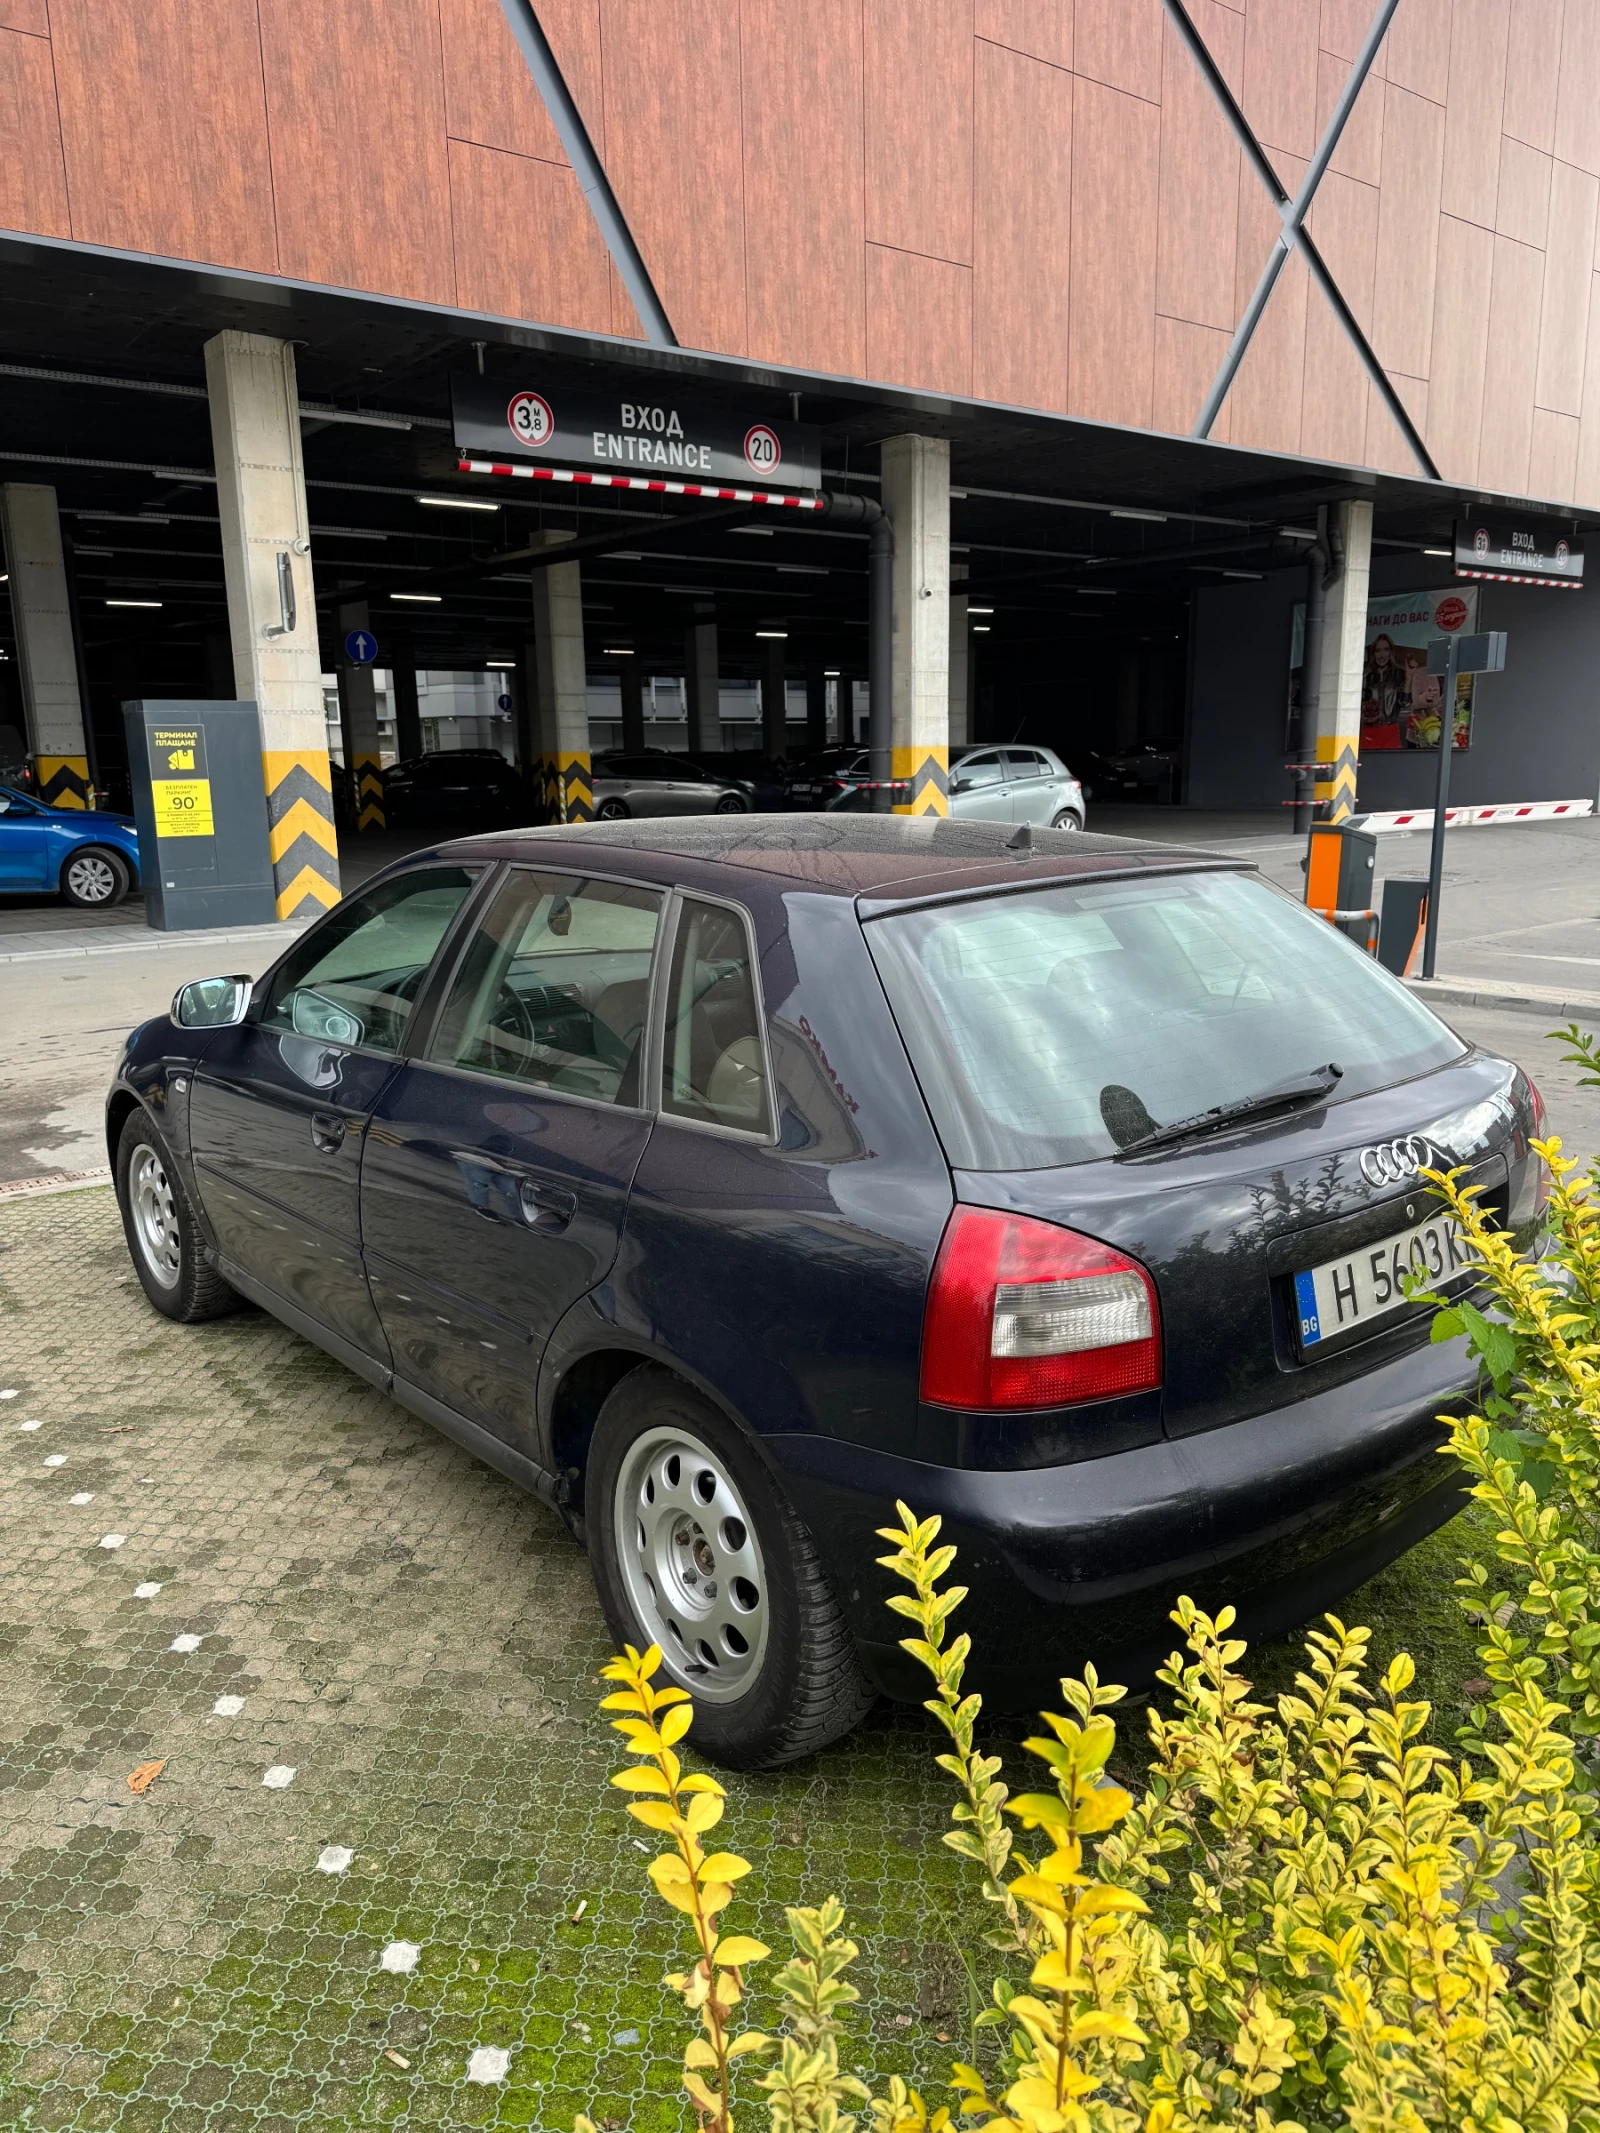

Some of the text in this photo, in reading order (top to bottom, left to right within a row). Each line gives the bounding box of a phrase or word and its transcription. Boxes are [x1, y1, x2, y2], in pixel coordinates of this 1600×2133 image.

[620, 403, 684, 439] ВХОД
[593, 432, 712, 470] ENTRANCE
[752, 437, 773, 462] 20
[1512, 532, 1535, 551] ВХОД
[1501, 549, 1544, 568] ENTRANCE
[1392, 613, 1407, 626] ДО
[1409, 611, 1430, 623] ВАС
[154, 731, 198, 739] ТЕРМИНАЛ
[155, 739, 196, 747] ПЛАЩАНЕ
[1332, 1263, 1358, 1323] H
[1369, 1228, 1444, 1305] 5603
[1301, 1315, 1318, 1337] BG
